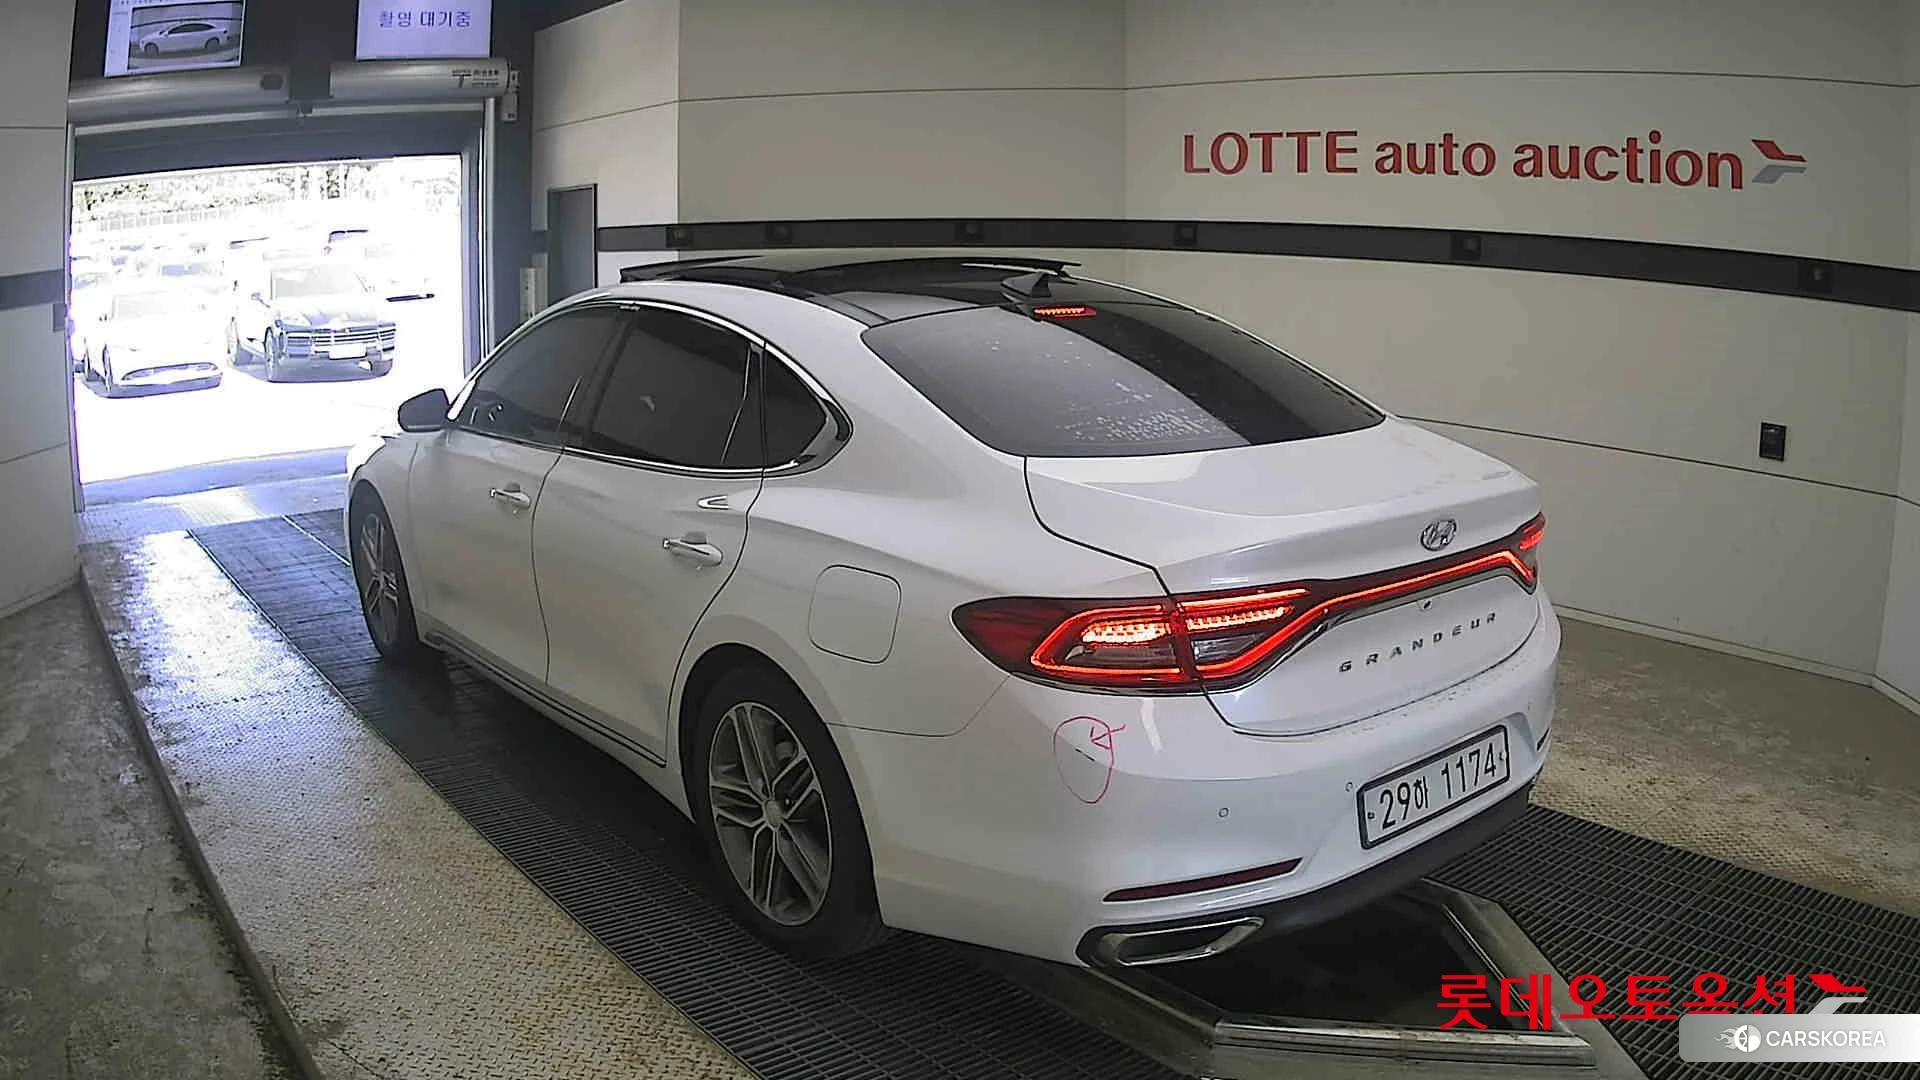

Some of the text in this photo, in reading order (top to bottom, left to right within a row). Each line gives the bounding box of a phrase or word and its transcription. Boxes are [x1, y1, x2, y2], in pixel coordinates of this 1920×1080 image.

[420, 11, 471, 28] 대기중
[1184, 130, 1743, 189] LOTTE auto auction
[1338, 611, 1498, 673] GRANDEUR
[1380, 742, 1497, 830] 29하 1174
